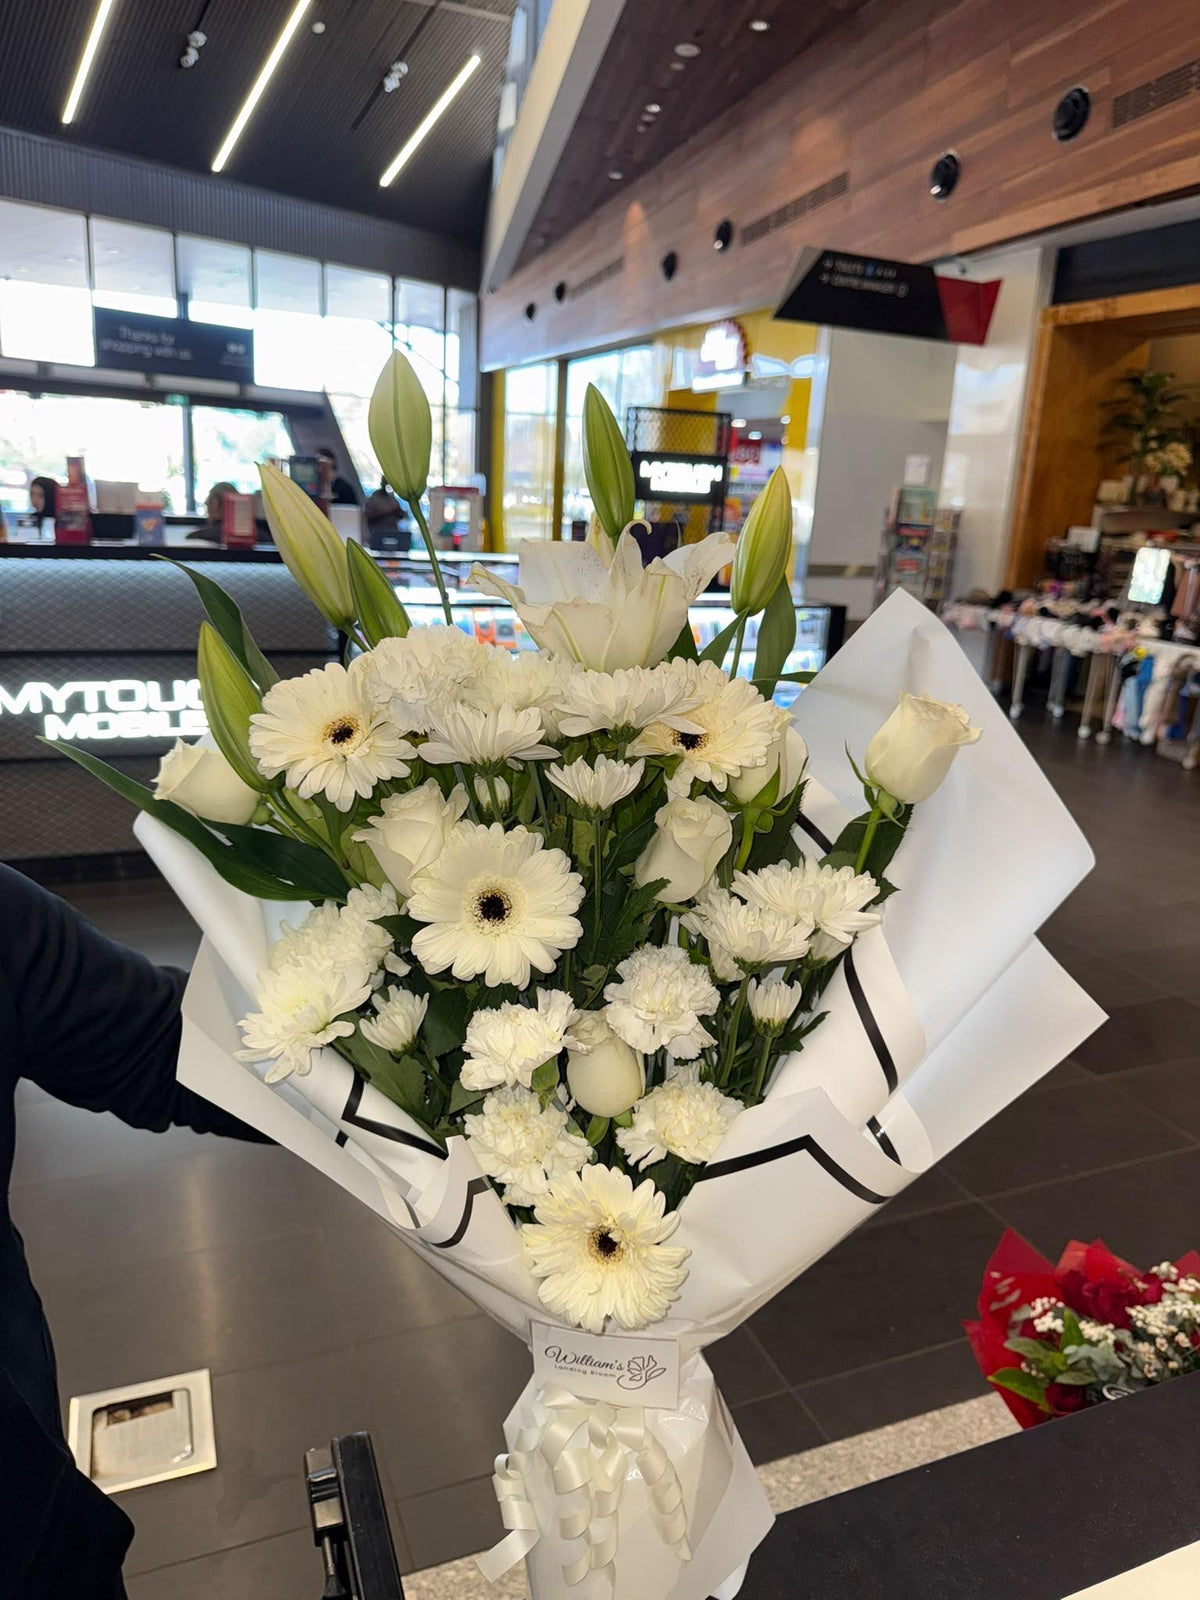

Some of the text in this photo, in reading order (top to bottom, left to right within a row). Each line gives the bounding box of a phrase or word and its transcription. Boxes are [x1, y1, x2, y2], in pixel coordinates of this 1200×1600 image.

[44, 710, 210, 741] MOBILE
[544, 1345, 625, 1371] William's
[554, 1364, 587, 1375] Landing
